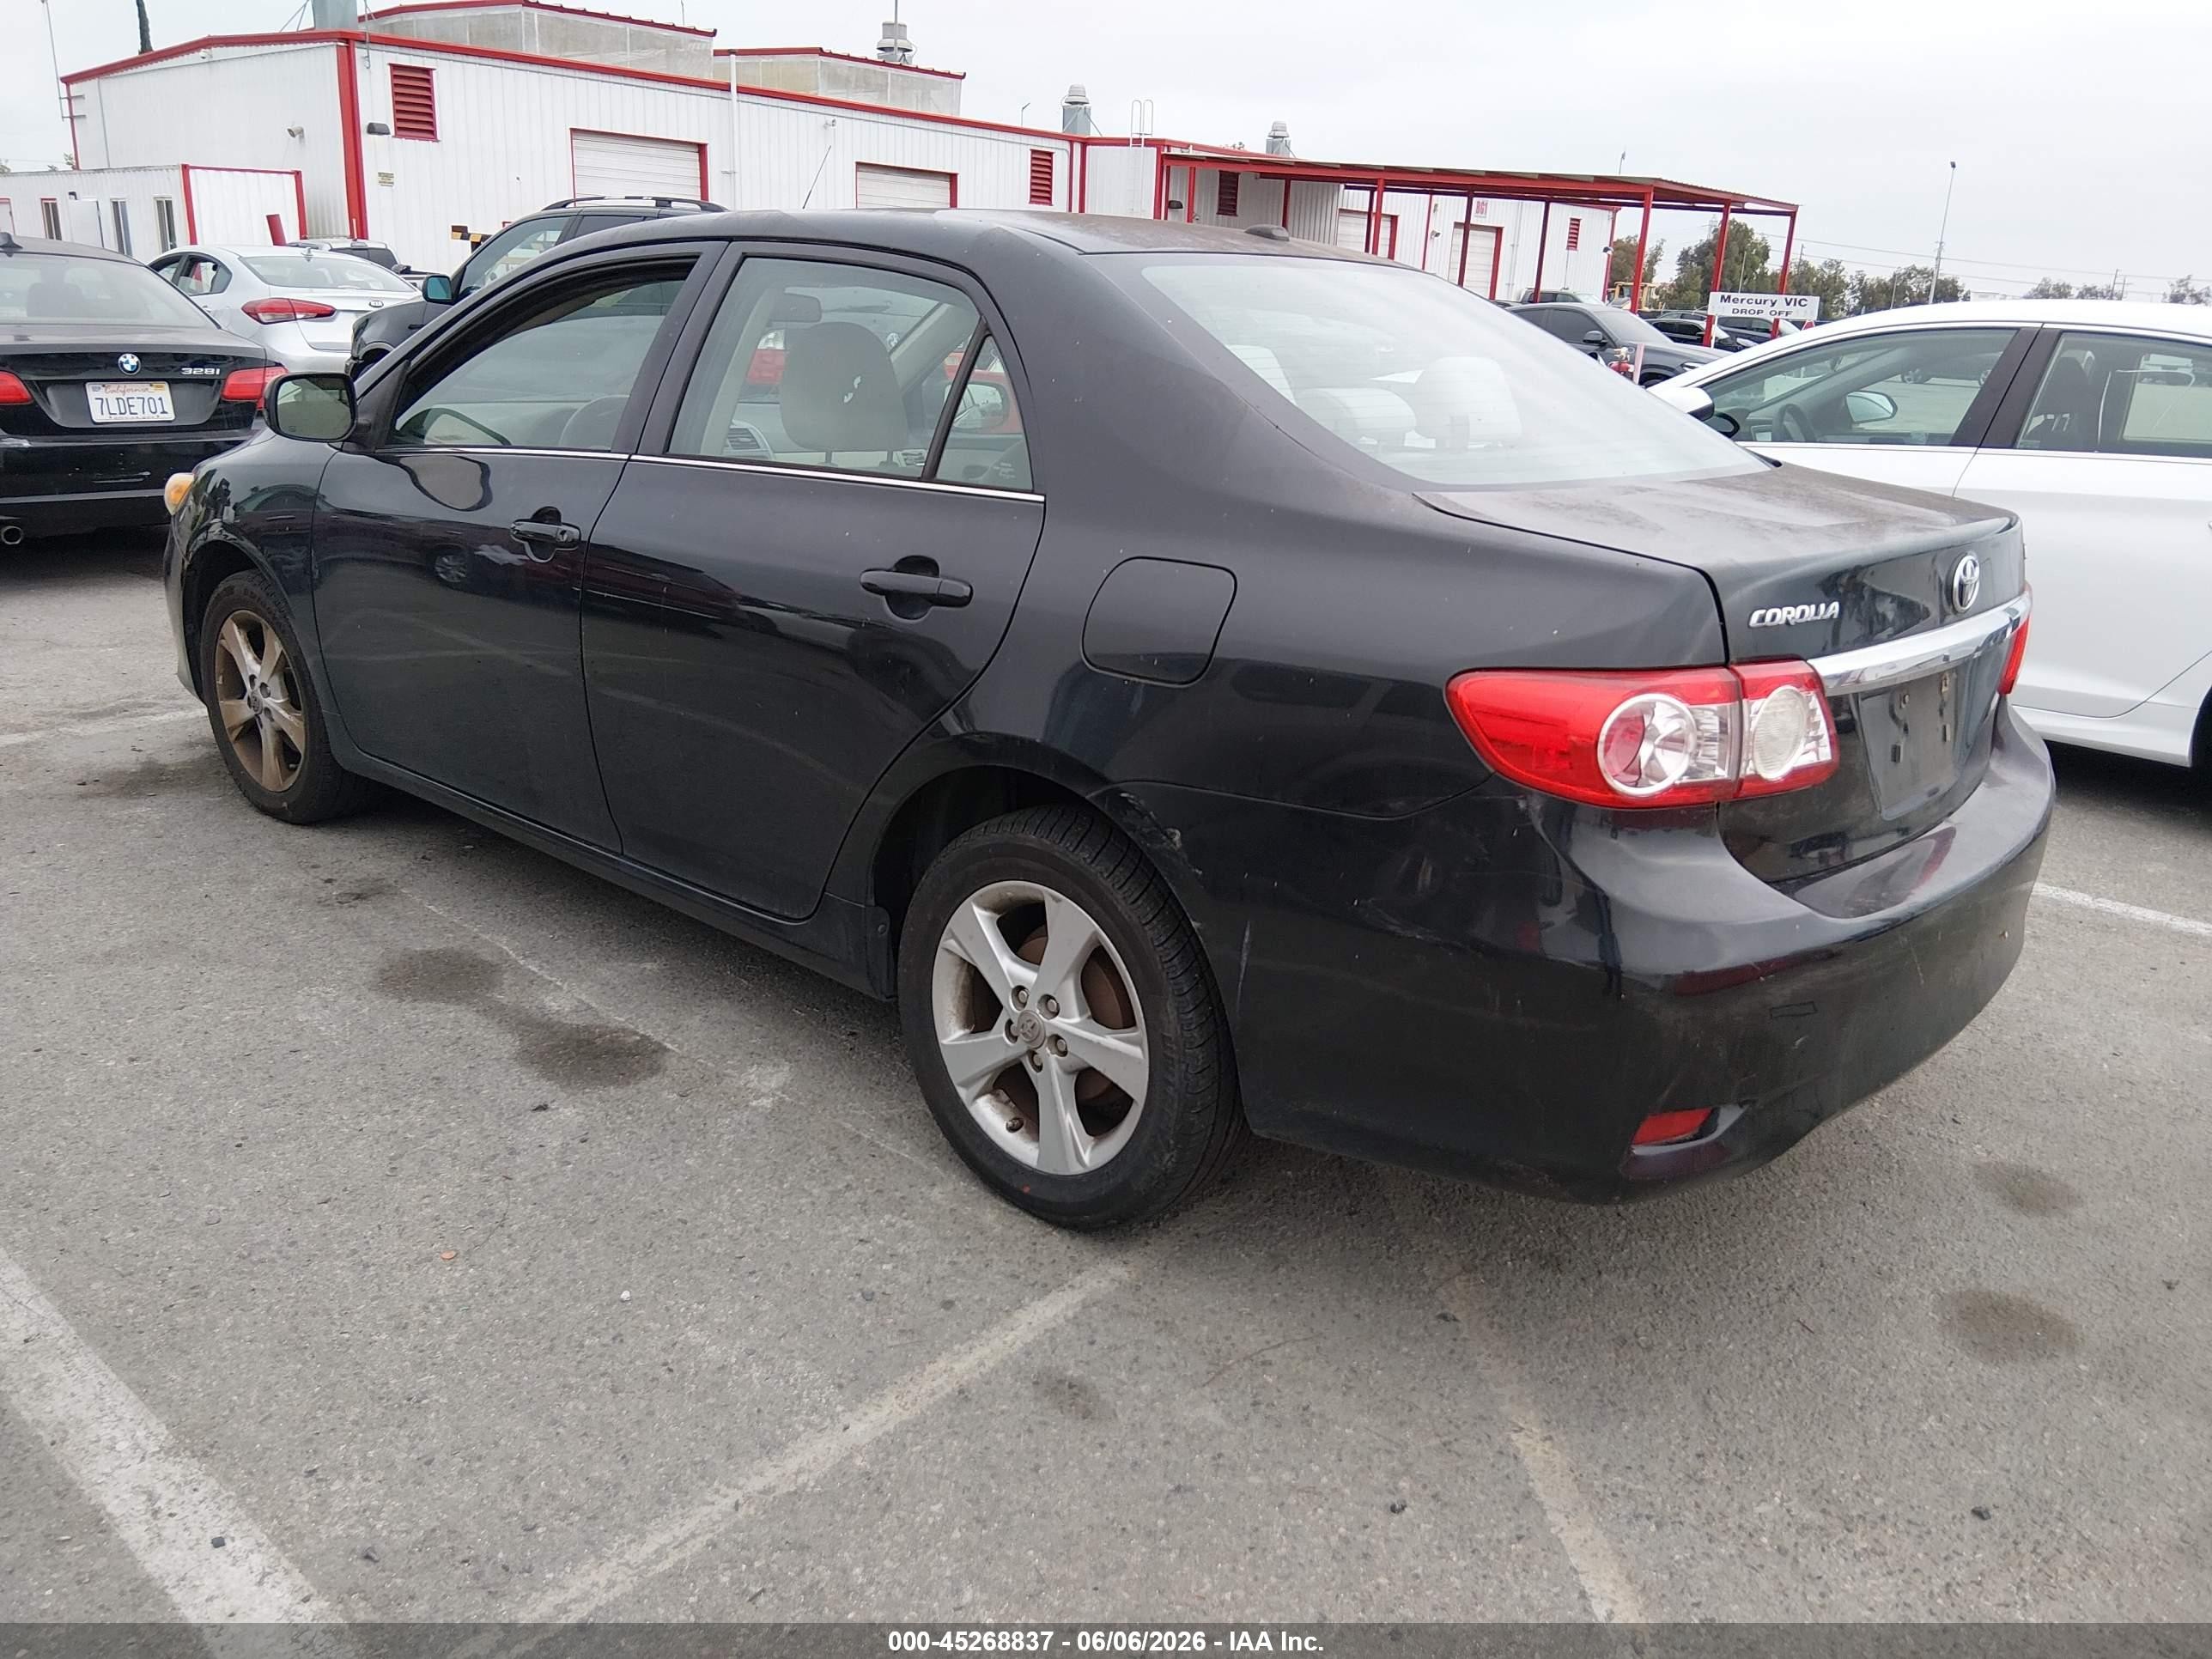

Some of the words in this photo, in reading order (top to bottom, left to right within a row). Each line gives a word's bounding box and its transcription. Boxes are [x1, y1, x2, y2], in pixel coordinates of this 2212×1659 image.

[1720, 295, 1777, 307] Mercury
[1784, 297, 1808, 307] VIC
[104, 384, 150, 395] California
[94, 397, 168, 416] 7LDE701
[1749, 601, 1839, 628] COROLLA
